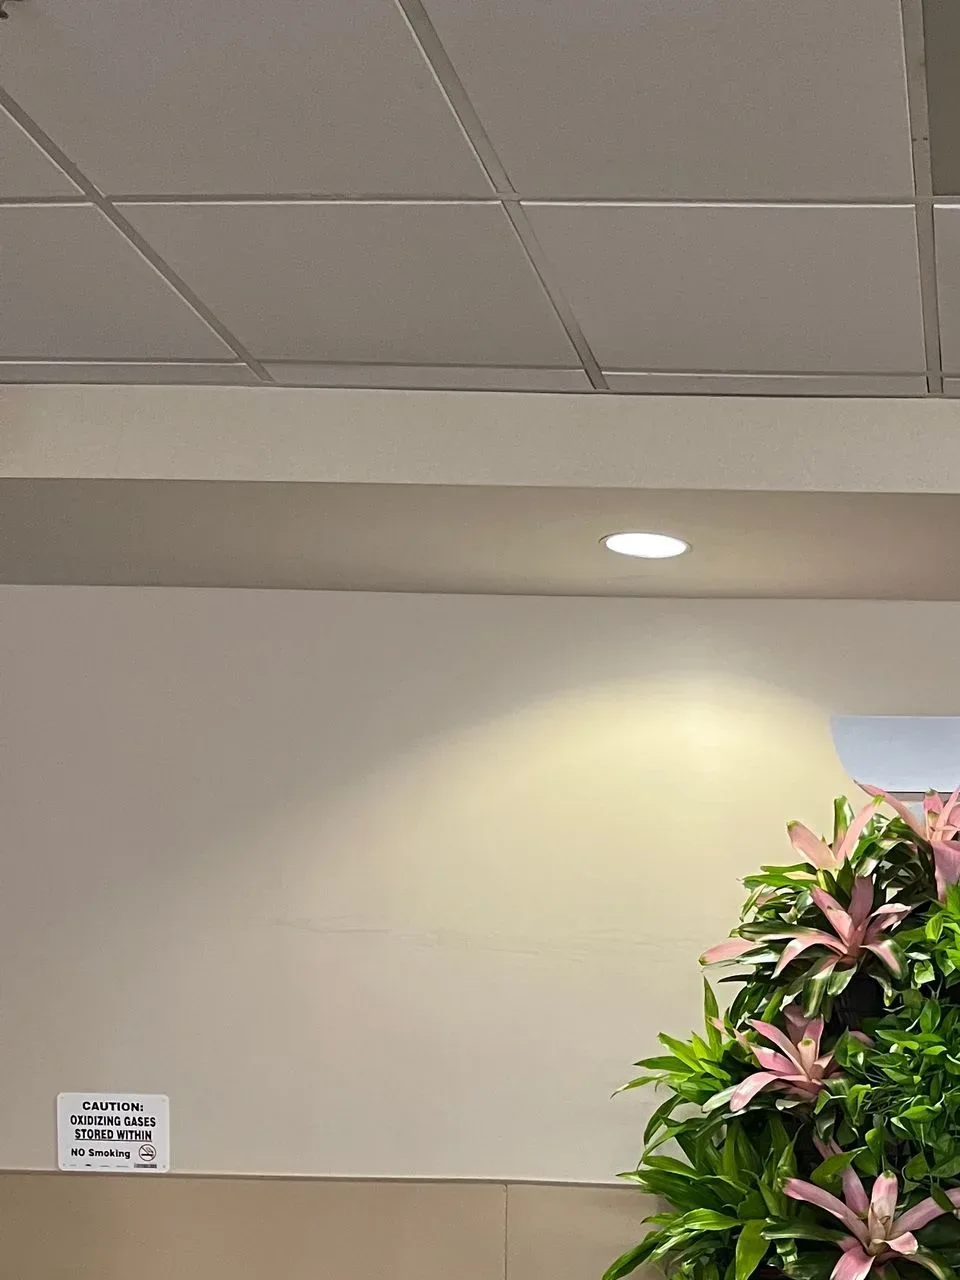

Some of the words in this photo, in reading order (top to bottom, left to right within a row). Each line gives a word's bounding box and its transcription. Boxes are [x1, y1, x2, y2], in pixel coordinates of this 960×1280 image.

[82, 1101, 144, 1112] CAUTION:
[70, 1115, 121, 1126] OXIDIZING
[124, 1116, 156, 1127] GASES
[75, 1129, 114, 1140] STORED
[117, 1130, 152, 1141] WITHIN
[71, 1148, 85, 1157] NO
[88, 1148, 131, 1160] Smoking
